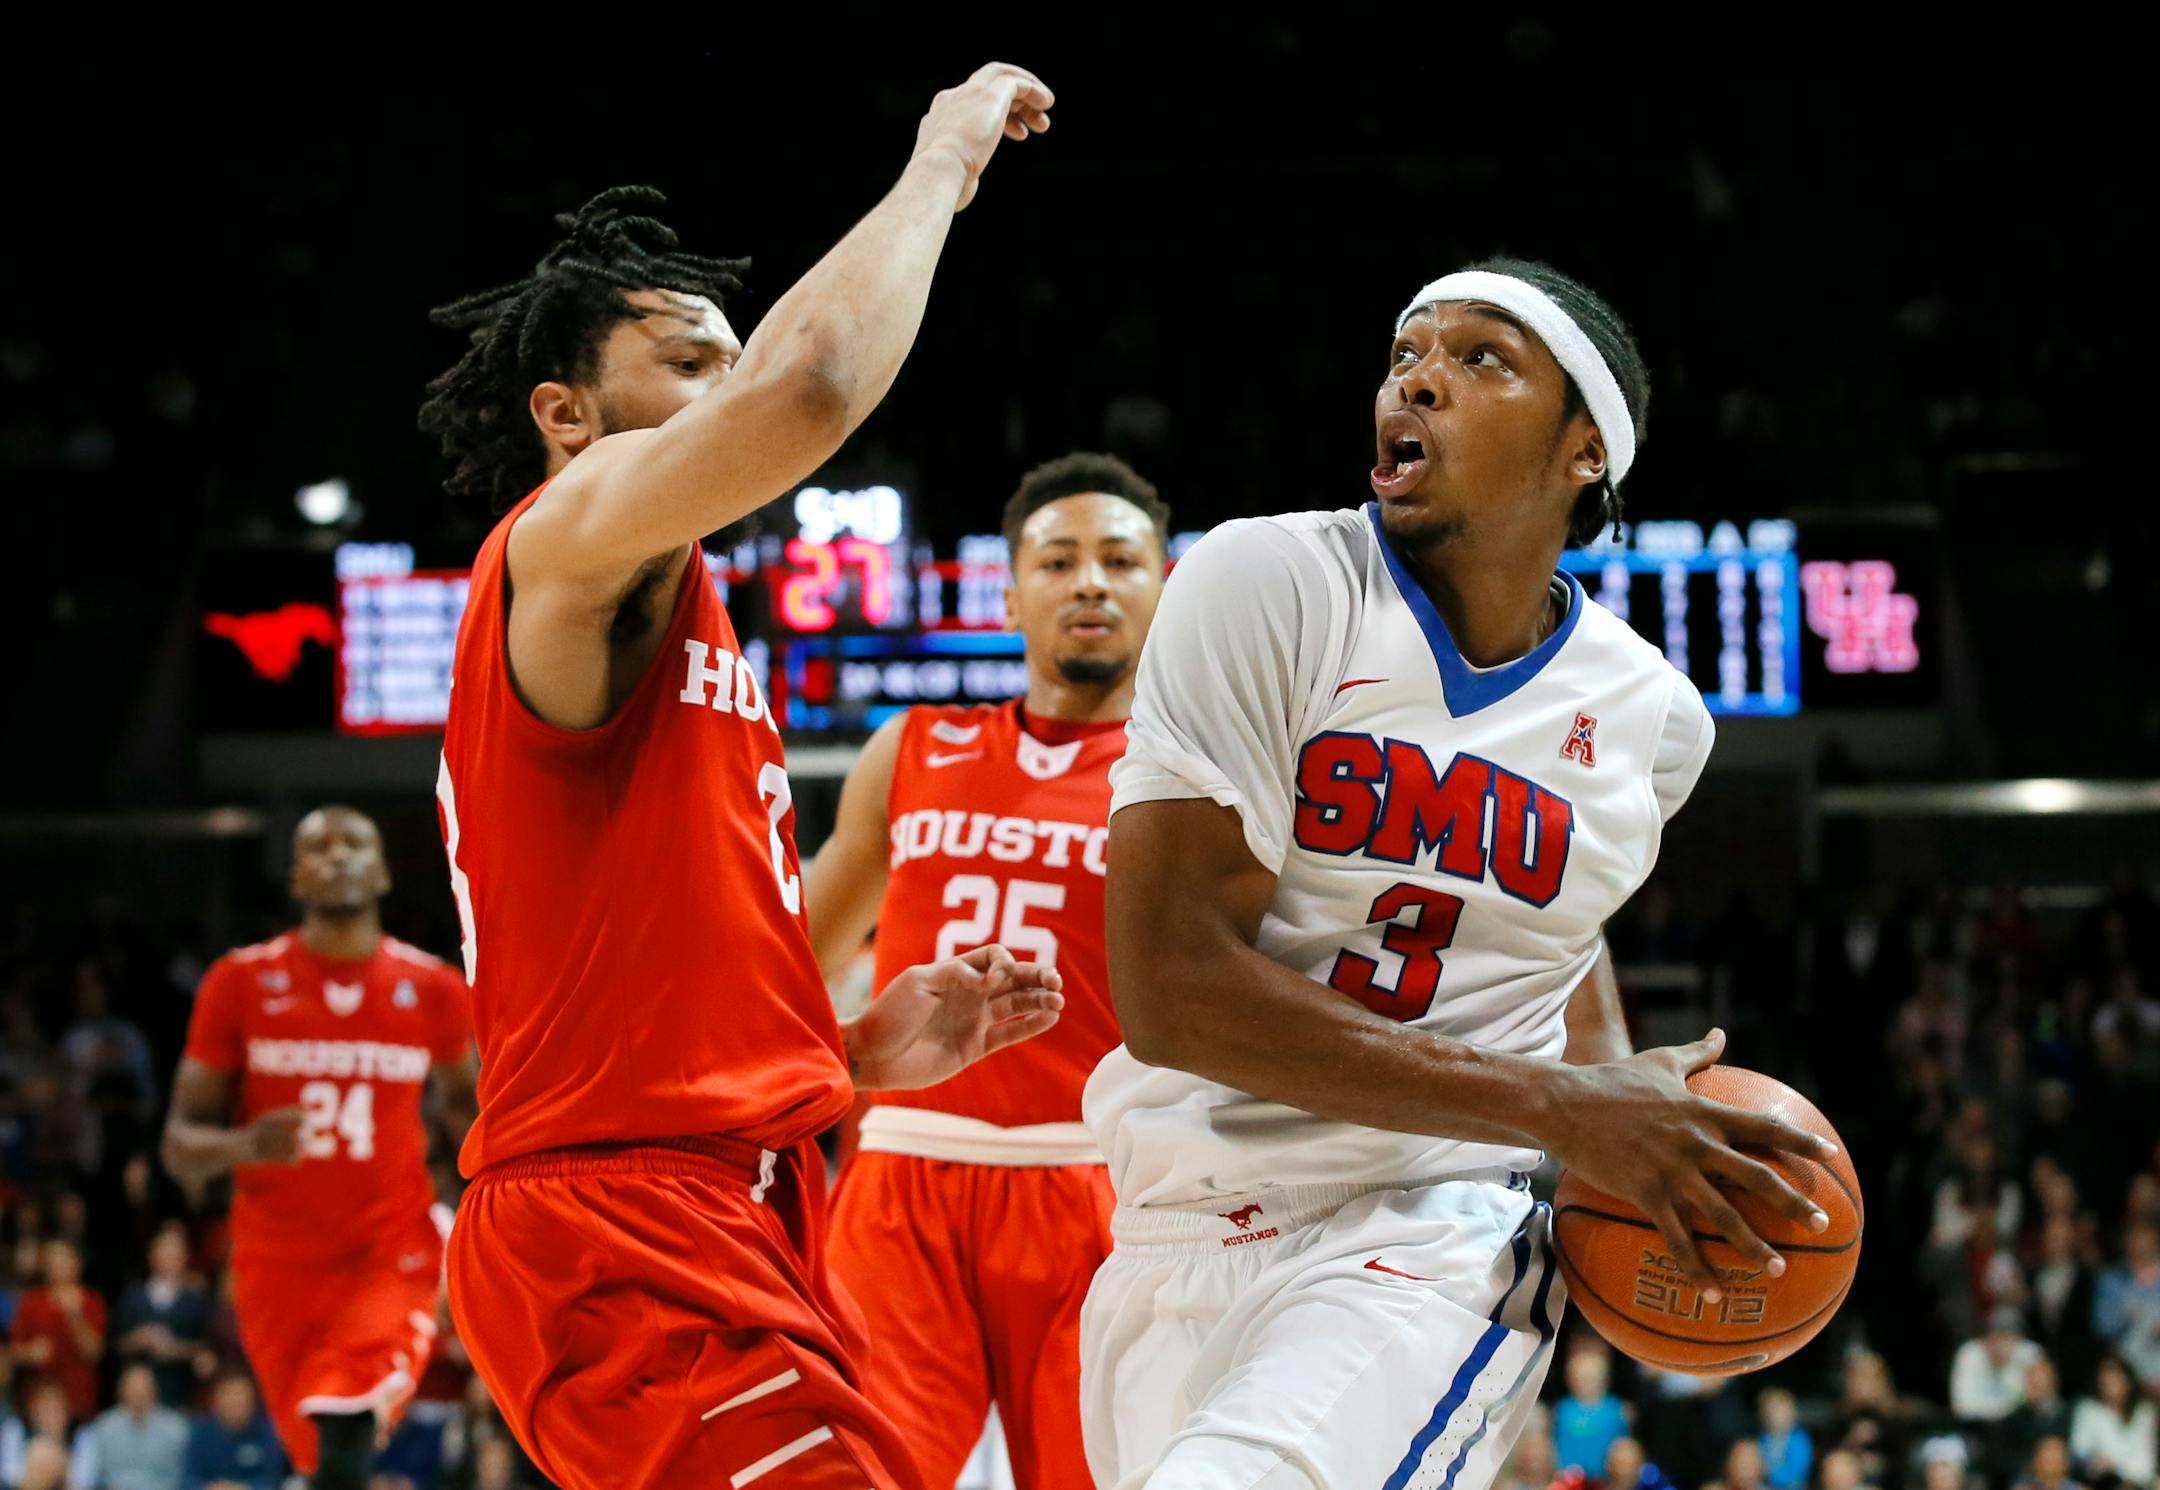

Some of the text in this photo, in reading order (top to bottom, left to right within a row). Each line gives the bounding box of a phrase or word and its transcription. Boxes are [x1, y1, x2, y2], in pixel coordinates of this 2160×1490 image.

[786, 535, 893, 632] 27
[891, 809, 1108, 876] OUSTO
[1293, 730, 1575, 910] SMU
[934, 873, 1066, 970] 25
[1328, 881, 1465, 1023] 3
[300, 1080, 374, 1160] 24
[1221, 1226, 1279, 1248] MUSTANGS
